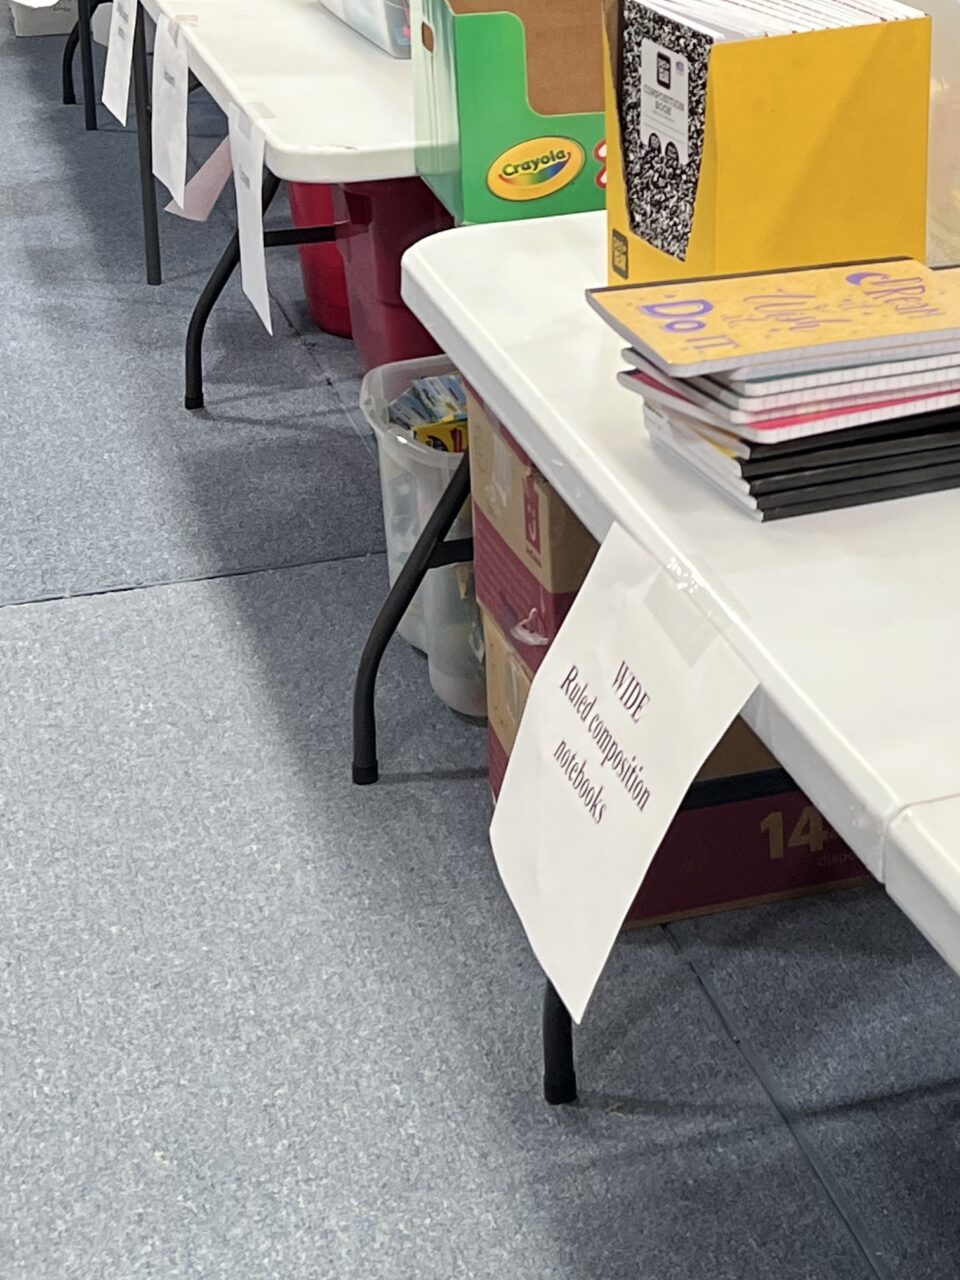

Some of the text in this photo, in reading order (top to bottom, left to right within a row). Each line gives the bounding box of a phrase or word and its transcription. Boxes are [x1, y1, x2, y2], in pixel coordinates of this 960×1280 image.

[502, 148, 568, 177] Crayola
[611, 659, 651, 724] WIDE
[559, 664, 651, 813] Ruled composition
[552, 739, 607, 825] notebooks
